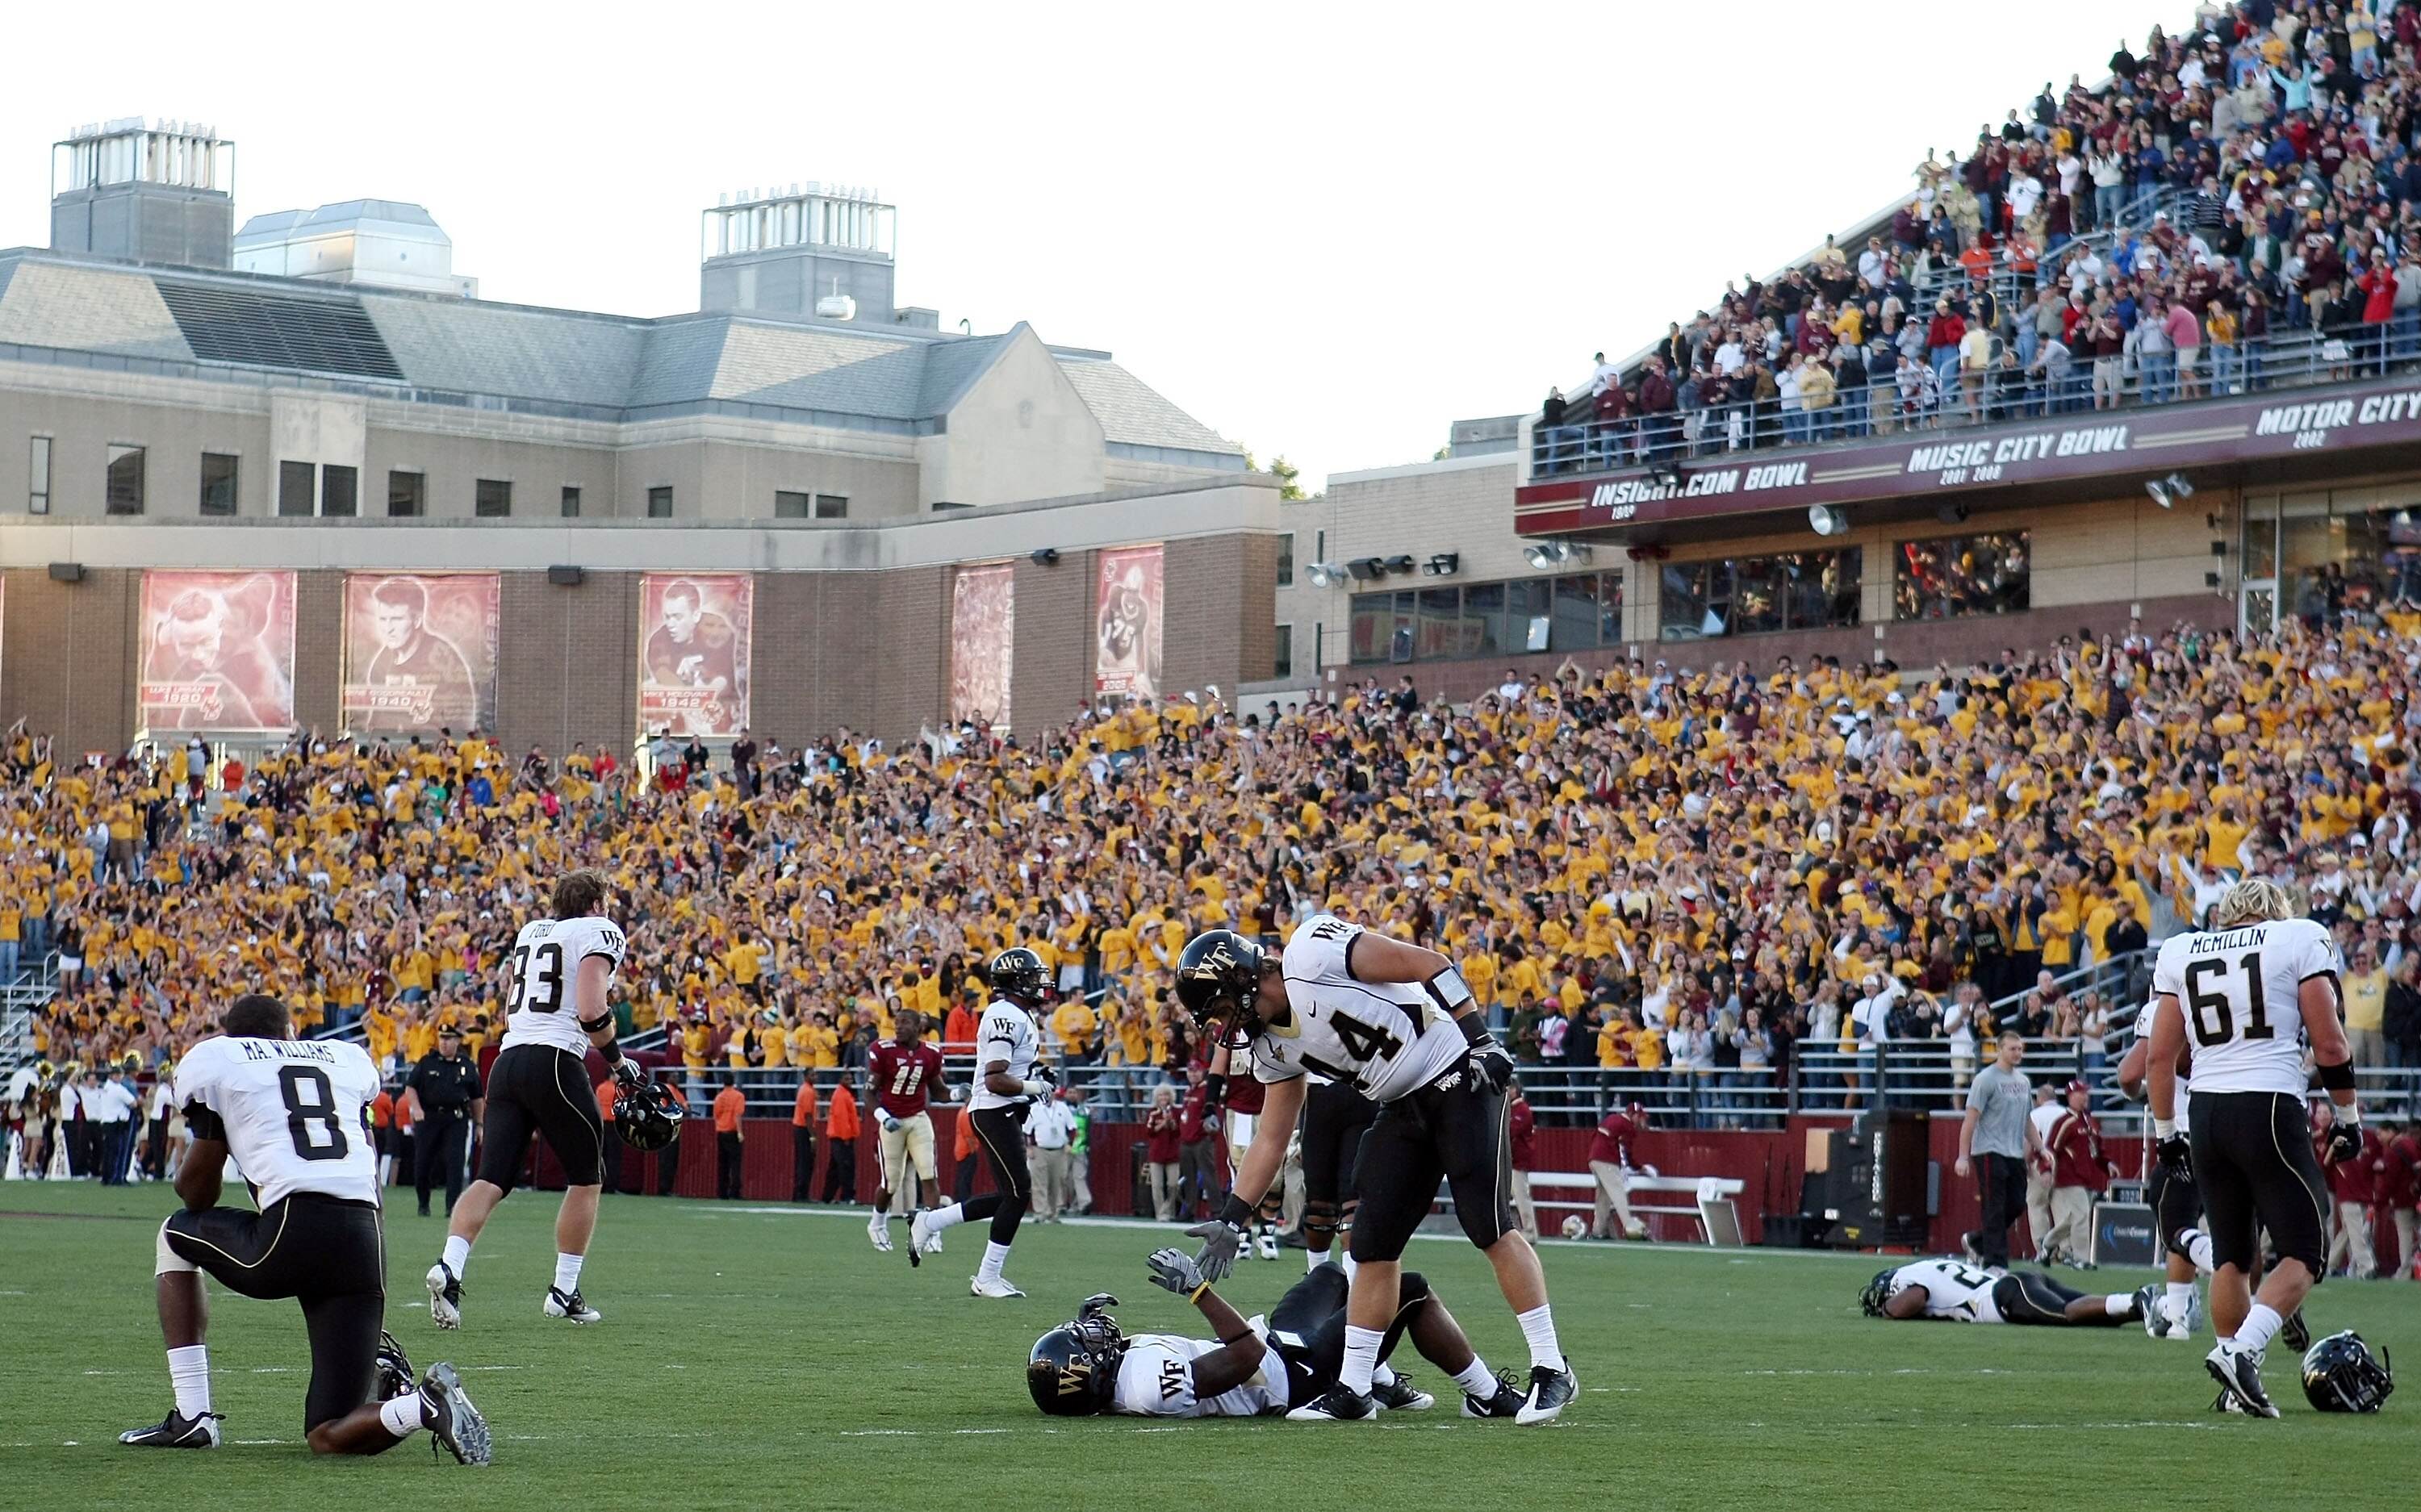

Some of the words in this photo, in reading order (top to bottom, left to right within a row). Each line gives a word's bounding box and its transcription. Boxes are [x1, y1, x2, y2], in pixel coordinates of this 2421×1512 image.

[2256, 399, 2354, 436] MOTOR
[2358, 392, 2421, 424] CITY
[1908, 441, 1991, 473] MUSIC
[1994, 433, 2056, 465] CITY
[2055, 425, 2130, 457] BOWL
[1743, 462, 1808, 491] BOWL
[1939, 468, 1967, 485] 2001
[370, 695, 411, 707] 1940
[661, 697, 700, 708] 1942
[600, 929, 624, 953] WF
[1311, 922, 1348, 941] WF
[997, 955, 1025, 970] WF
[1194, 942, 1237, 980] WF
[2185, 952, 2274, 1047] 61
[993, 1017, 1016, 1034] WF
[240, 1042, 272, 1060] MA.
[271, 1040, 336, 1063] WILLIAMS
[891, 1066, 924, 1096] 11
[278, 1065, 349, 1161] 8
[1058, 1353, 1092, 1396] WF
[1159, 1359, 1188, 1401] WF
